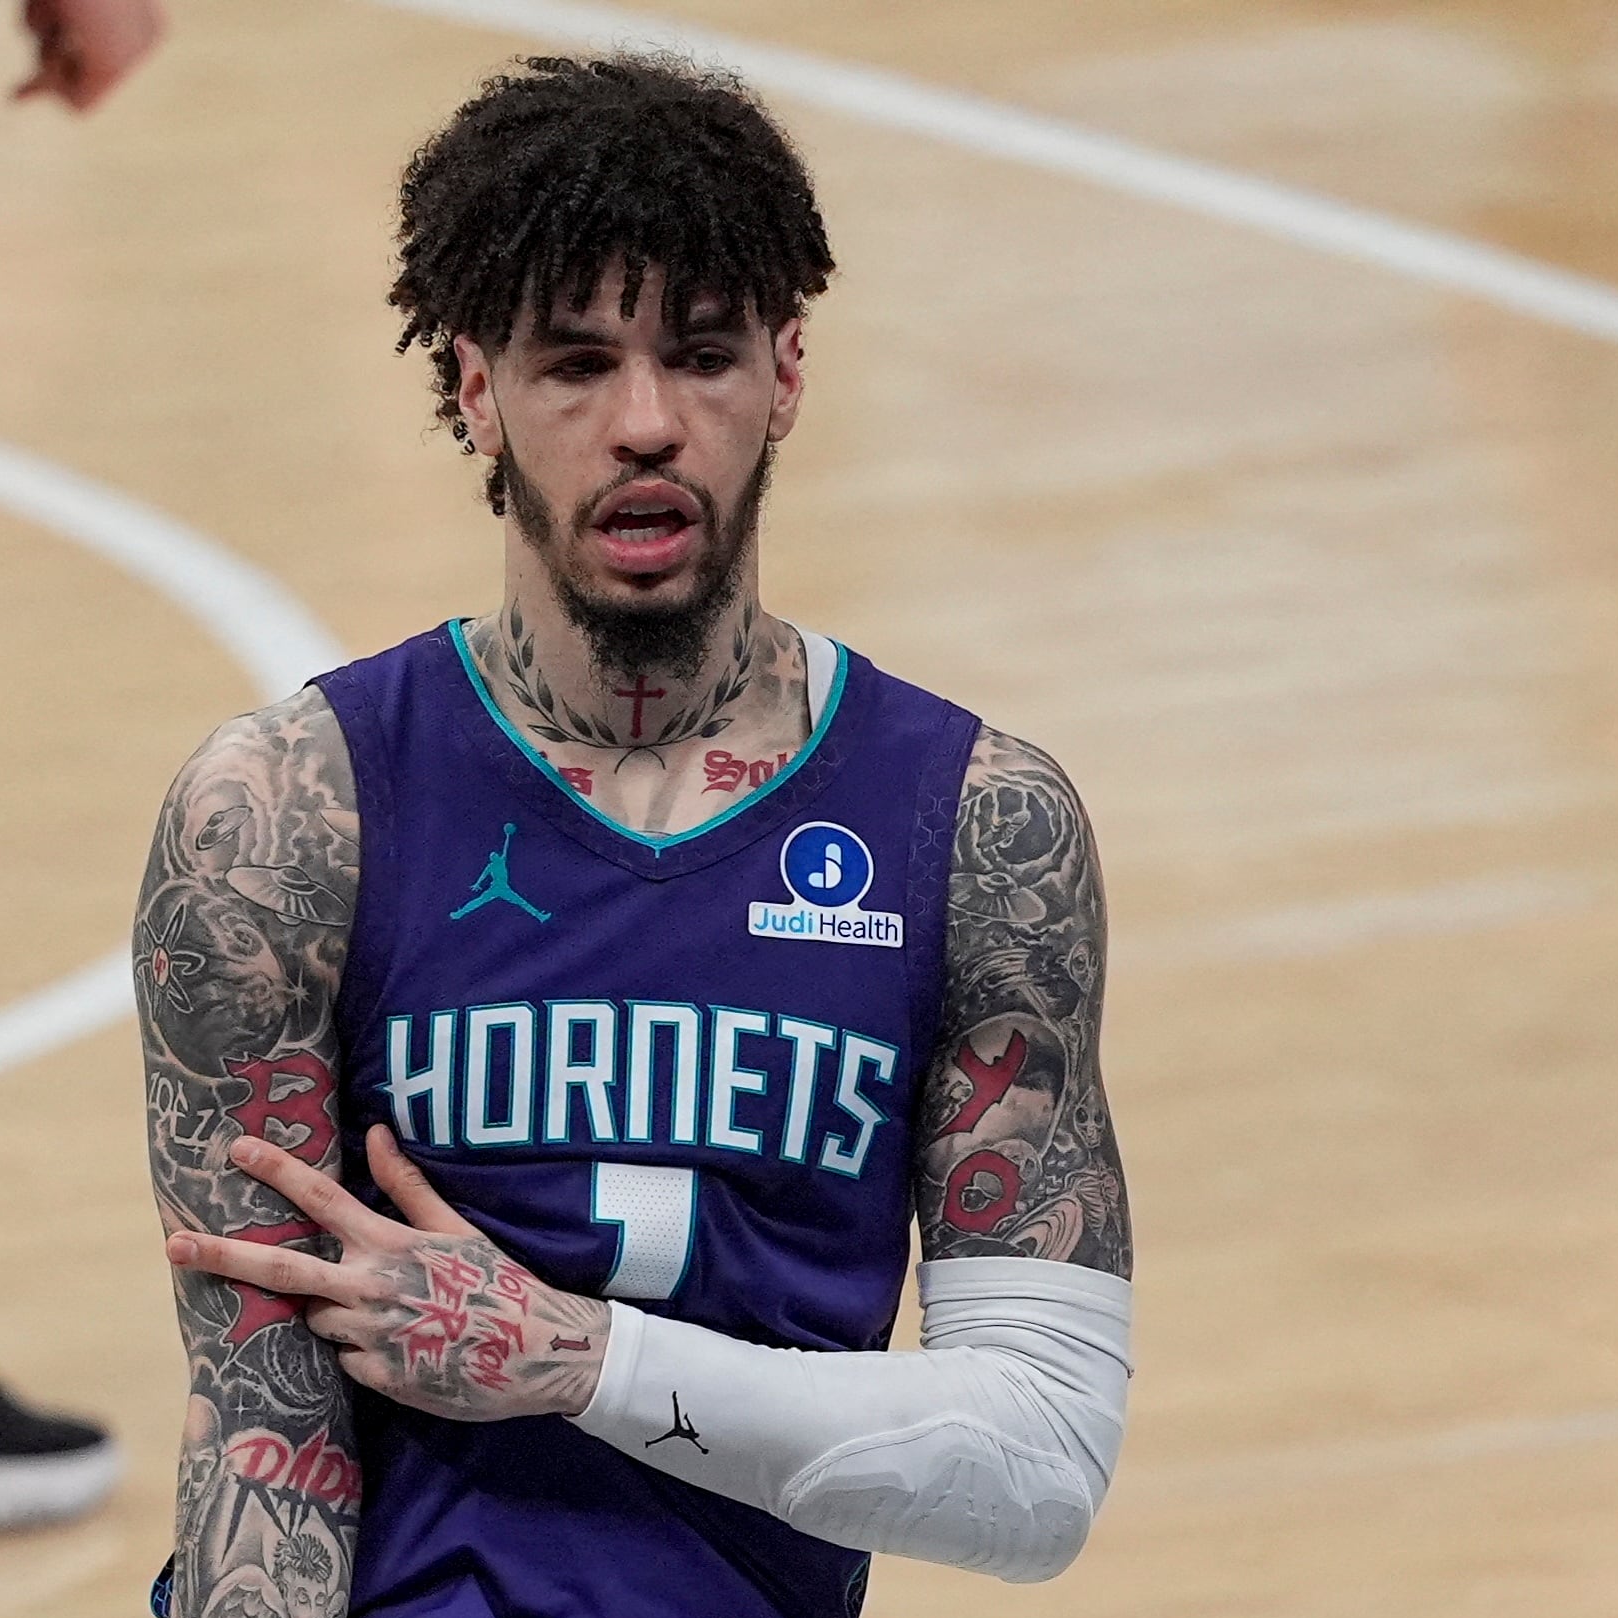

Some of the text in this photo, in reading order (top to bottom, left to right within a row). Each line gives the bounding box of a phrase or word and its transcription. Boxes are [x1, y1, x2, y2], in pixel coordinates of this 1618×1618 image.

[754, 907, 899, 943] Judi Health
[372, 999, 900, 1180] HORNETS
[485, 1256, 538, 1317] NOT
[590, 1161, 699, 1300] 1
[393, 1251, 483, 1376] HERE
